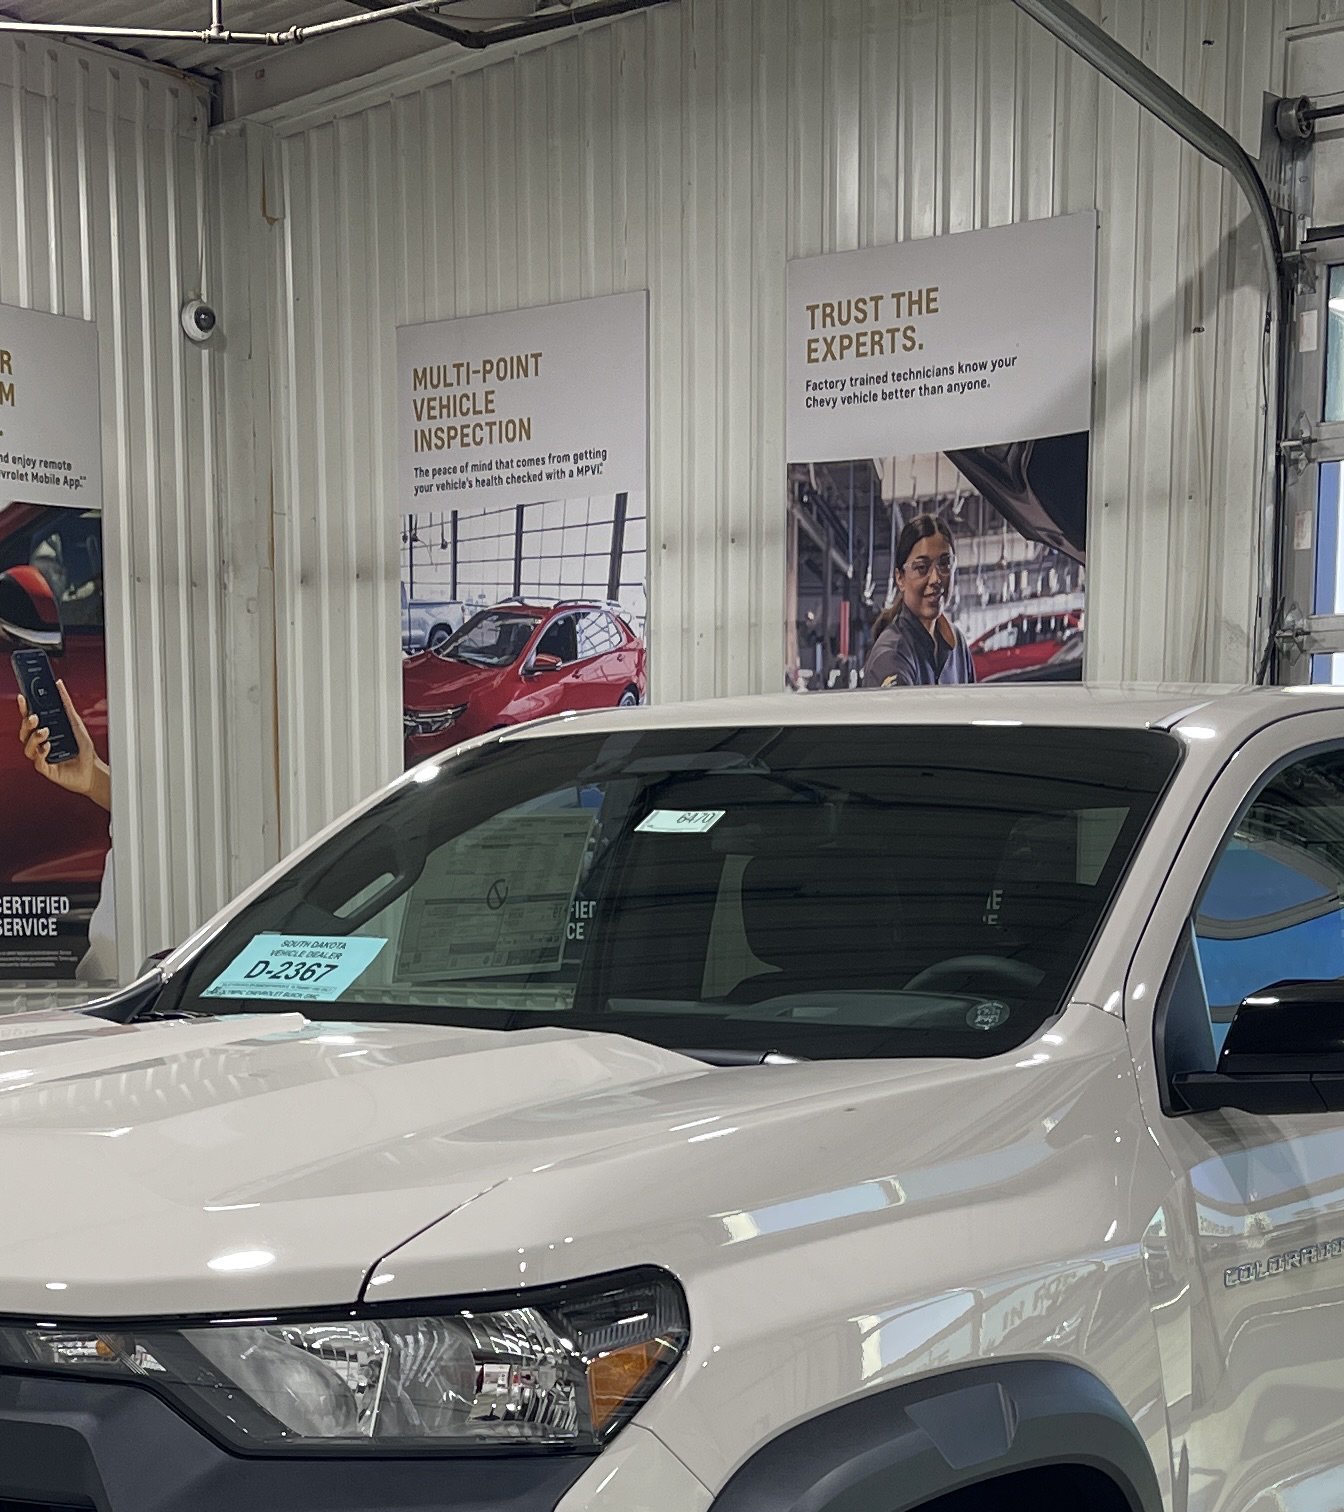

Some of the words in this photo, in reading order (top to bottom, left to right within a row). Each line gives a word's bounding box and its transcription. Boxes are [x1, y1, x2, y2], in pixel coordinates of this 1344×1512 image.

[806, 295, 885, 331] TRUST
[891, 287, 939, 319] THE
[807, 325, 925, 364] EXPERTS.
[412, 352, 543, 391] MULTI-POINT
[806, 376, 847, 391] Factory
[850, 371, 889, 387] trained
[891, 364, 955, 383] technicians
[958, 359, 987, 374] know
[991, 356, 1017, 373] your
[412, 390, 496, 422] VEHICLE
[806, 393, 838, 409] Chevy
[841, 389, 878, 405] vehicle
[881, 387, 916, 401] better
[919, 383, 944, 397] than
[947, 378, 991, 395] anyone.
[414, 417, 532, 452] INSPECTION
[12, 455, 37, 470] enjoy
[39, 458, 72, 472] remote
[31, 472, 60, 486] Mobile
[414, 467, 430, 478] The
[432, 466, 458, 479] peace
[460, 462, 469, 473] of
[471, 460, 493, 473] mind
[495, 458, 514, 471] that
[516, 457, 546, 468] comes
[548, 453, 571, 464] from
[573, 448, 607, 465] getting
[414, 483, 433, 496] your
[436, 477, 473, 492] vehicle's
[475, 475, 504, 488] health
[506, 470, 543, 485] checked
[545, 469, 566, 481] with
[568, 469, 574, 478] a
[270, 950, 308, 958] VEHICLE
[306, 951, 343, 960] DEALER
[281, 940, 310, 949] SOUTH
[311, 940, 347, 949] DAKOTA
[244, 960, 339, 982] D-2367
